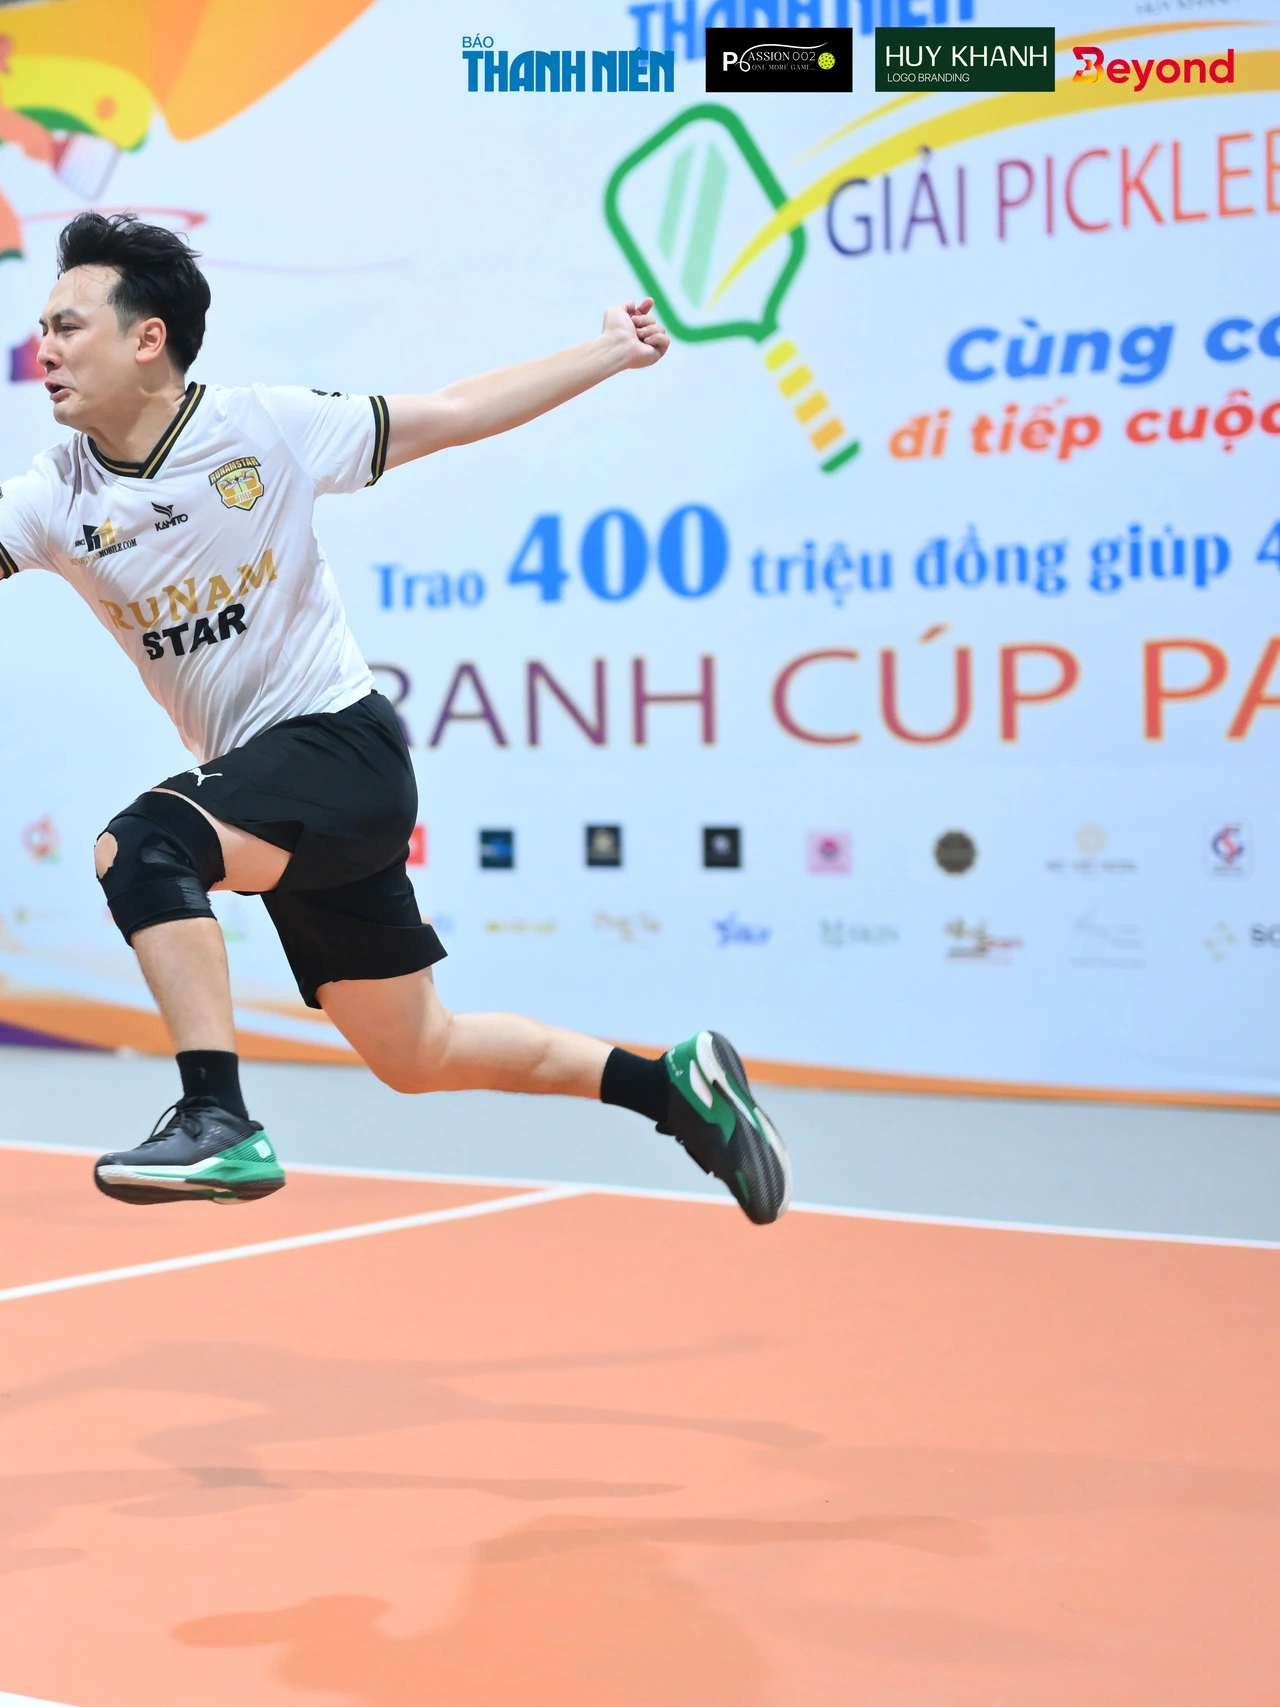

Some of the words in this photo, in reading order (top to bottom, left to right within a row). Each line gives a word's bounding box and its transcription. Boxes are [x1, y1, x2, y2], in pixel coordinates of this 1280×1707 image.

[825, 145, 966, 258] GIẢI
[945, 316, 1175, 386] Cùng
[888, 407, 952, 461] đi
[970, 394, 1102, 462] tiếp
[209, 457, 260, 485] RUNAMSTAR
[154, 513, 189, 532] KAMITO
[372, 562, 486, 612] Trao
[506, 502, 732, 604] 400
[749, 539, 893, 609] triệu
[914, 521, 1068, 597] đồng
[1089, 521, 1232, 595] giúp
[99, 548, 277, 630] RUNAM
[142, 603, 248, 661] STAR
[770, 622, 1082, 746] CÚP
